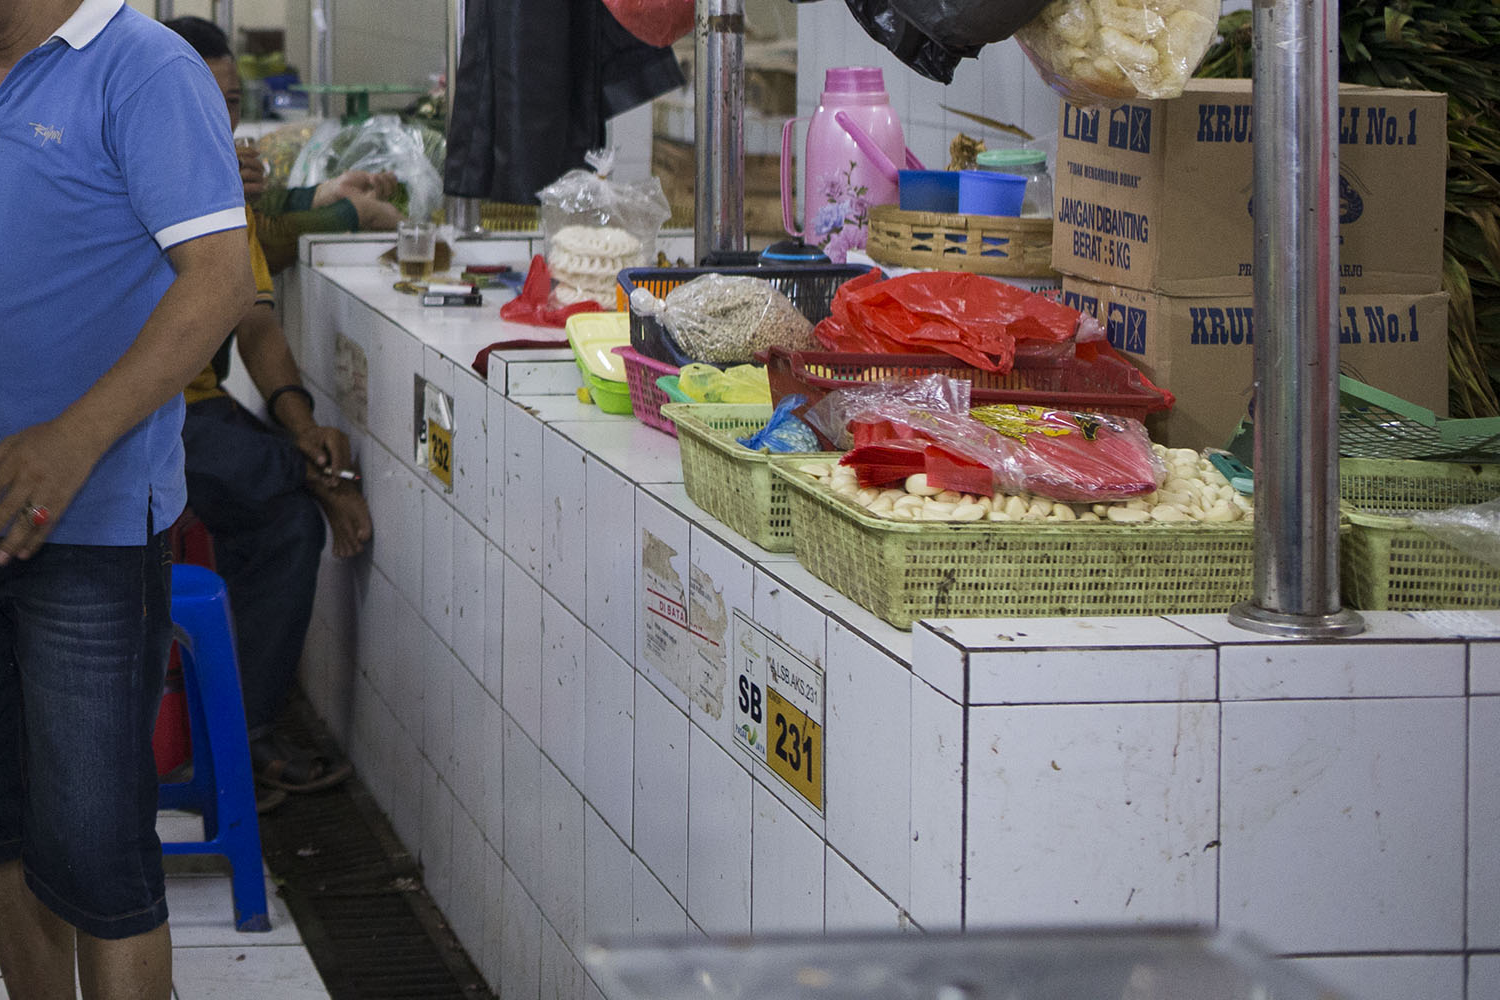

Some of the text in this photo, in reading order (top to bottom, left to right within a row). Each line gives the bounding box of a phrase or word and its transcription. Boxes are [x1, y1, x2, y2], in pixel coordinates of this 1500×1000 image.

[1339, 106, 1361, 145] LI
[1365, 106, 1418, 145] No.1
[1058, 196, 1149, 244] JANGAN DIBANTING
[1073, 229, 1102, 264] BERAT
[1109, 239, 1115, 267] 5
[1116, 241, 1131, 271] KG
[1339, 306, 1362, 344] LI
[1364, 303, 1419, 343] No.1
[431, 433, 449, 473] 232
[659, 600, 666, 613] DI
[738, 673, 762, 725] SB
[774, 712, 813, 784] 231
